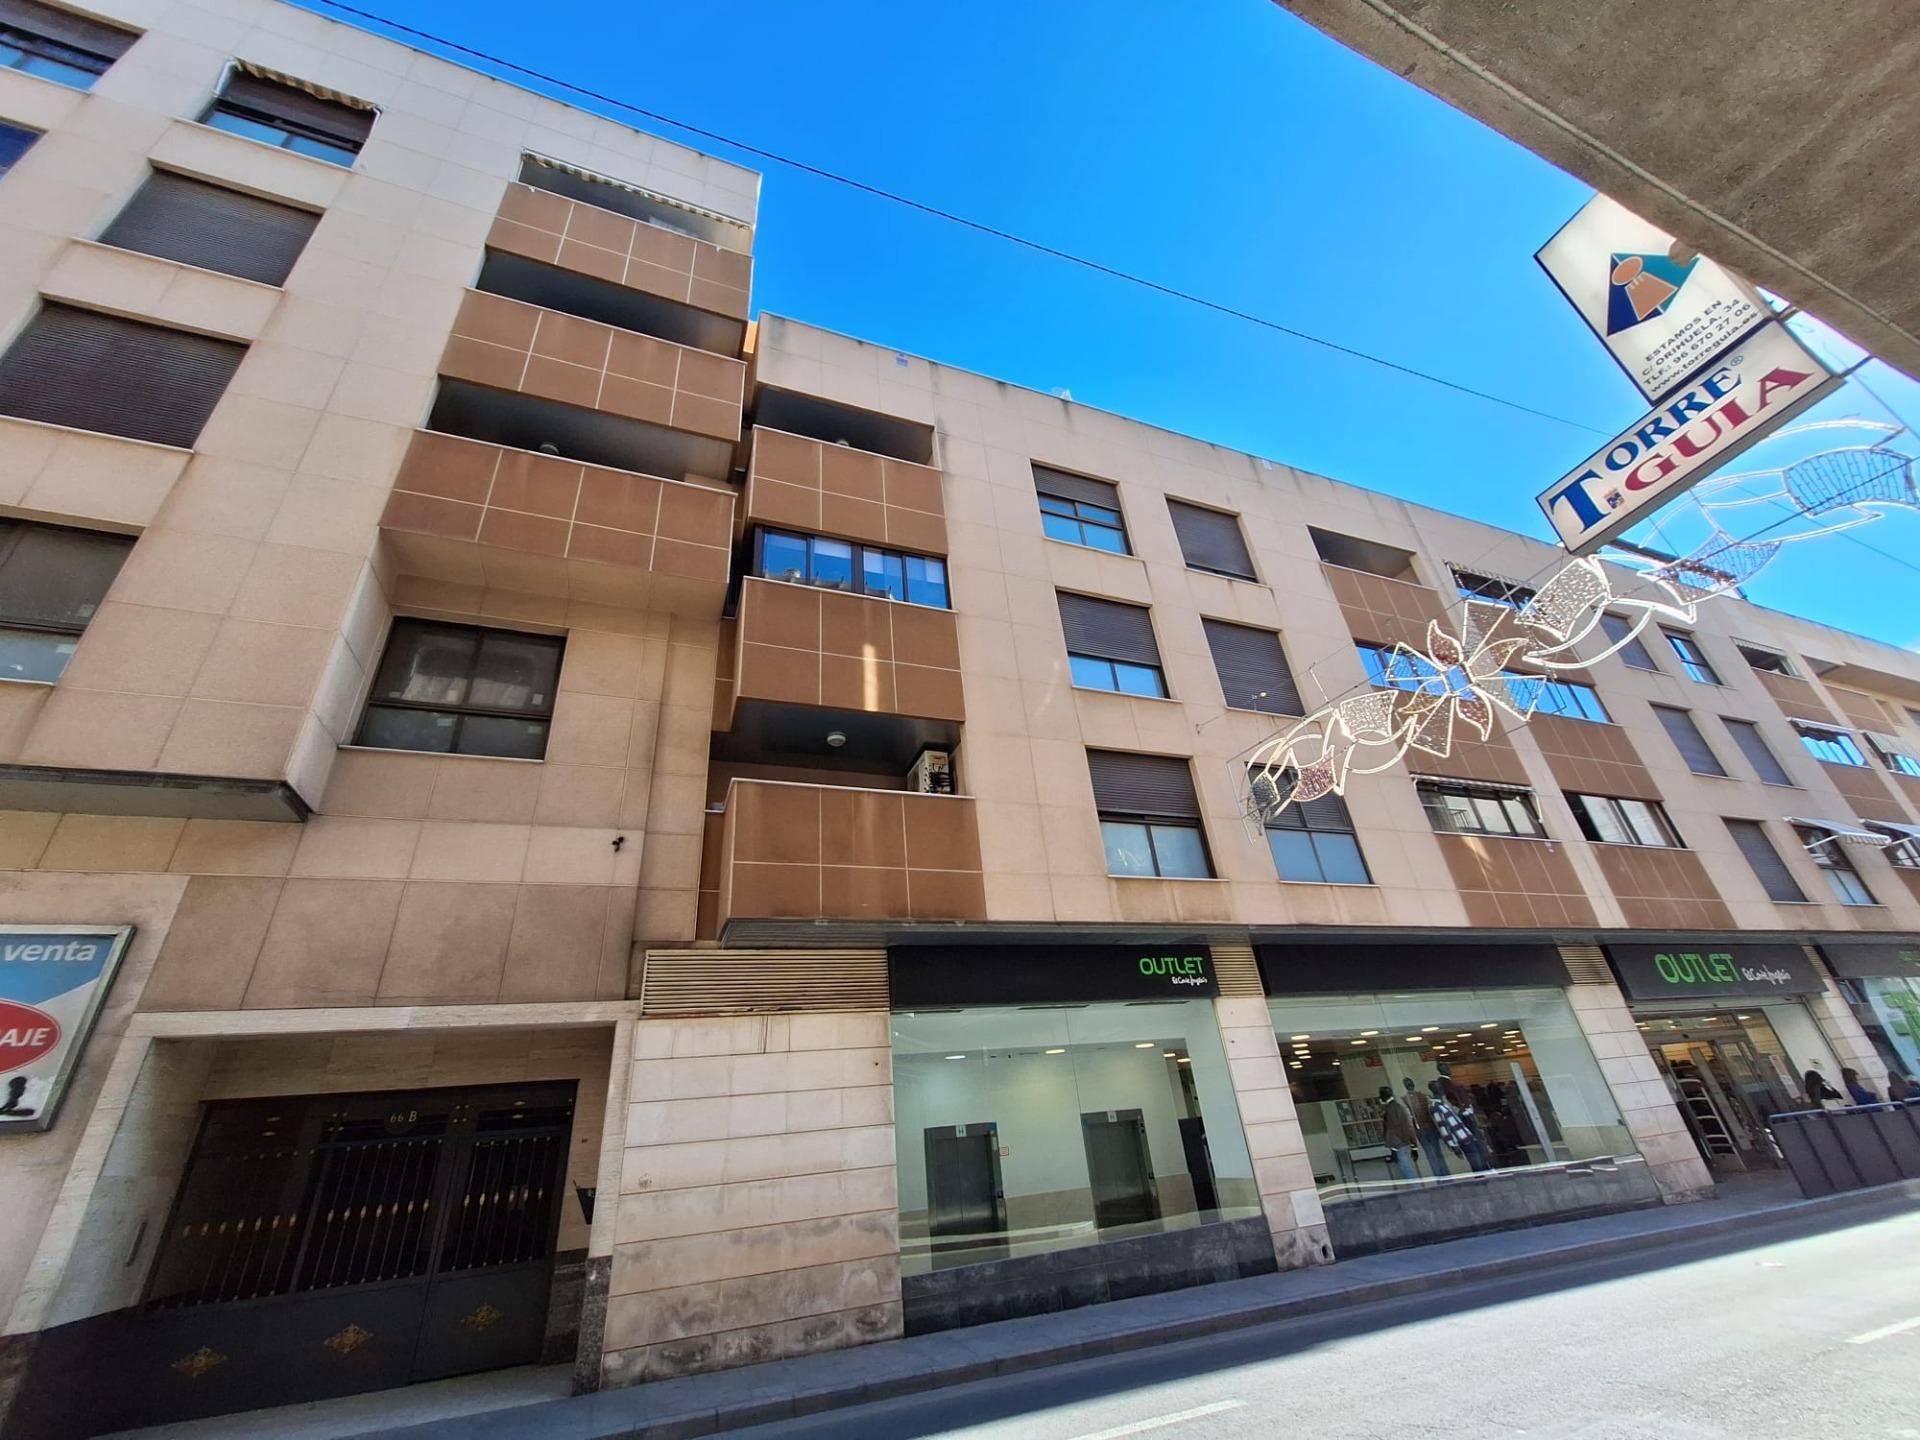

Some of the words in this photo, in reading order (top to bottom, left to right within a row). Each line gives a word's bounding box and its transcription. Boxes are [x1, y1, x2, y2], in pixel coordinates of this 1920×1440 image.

[1645, 317, 1702, 362] ESTAMOS
[1703, 300, 1722, 316] EN
[1651, 312, 1758, 392] www.torreguia.es
[1655, 316, 1722, 366] ORIHUELA,
[1723, 299, 1740, 313] 34
[1672, 351, 1689, 364] 96
[1690, 332, 1714, 350] 670
[1715, 317, 1731, 331] 27
[1734, 303, 1751, 317] 06
[1624, 366, 1815, 492] GUIA
[4, 941, 97, 961] venta
[1139, 956, 1203, 975] OUTLET
[1653, 953, 1742, 984] OUTLET
[408, 1110, 418, 1122] B
